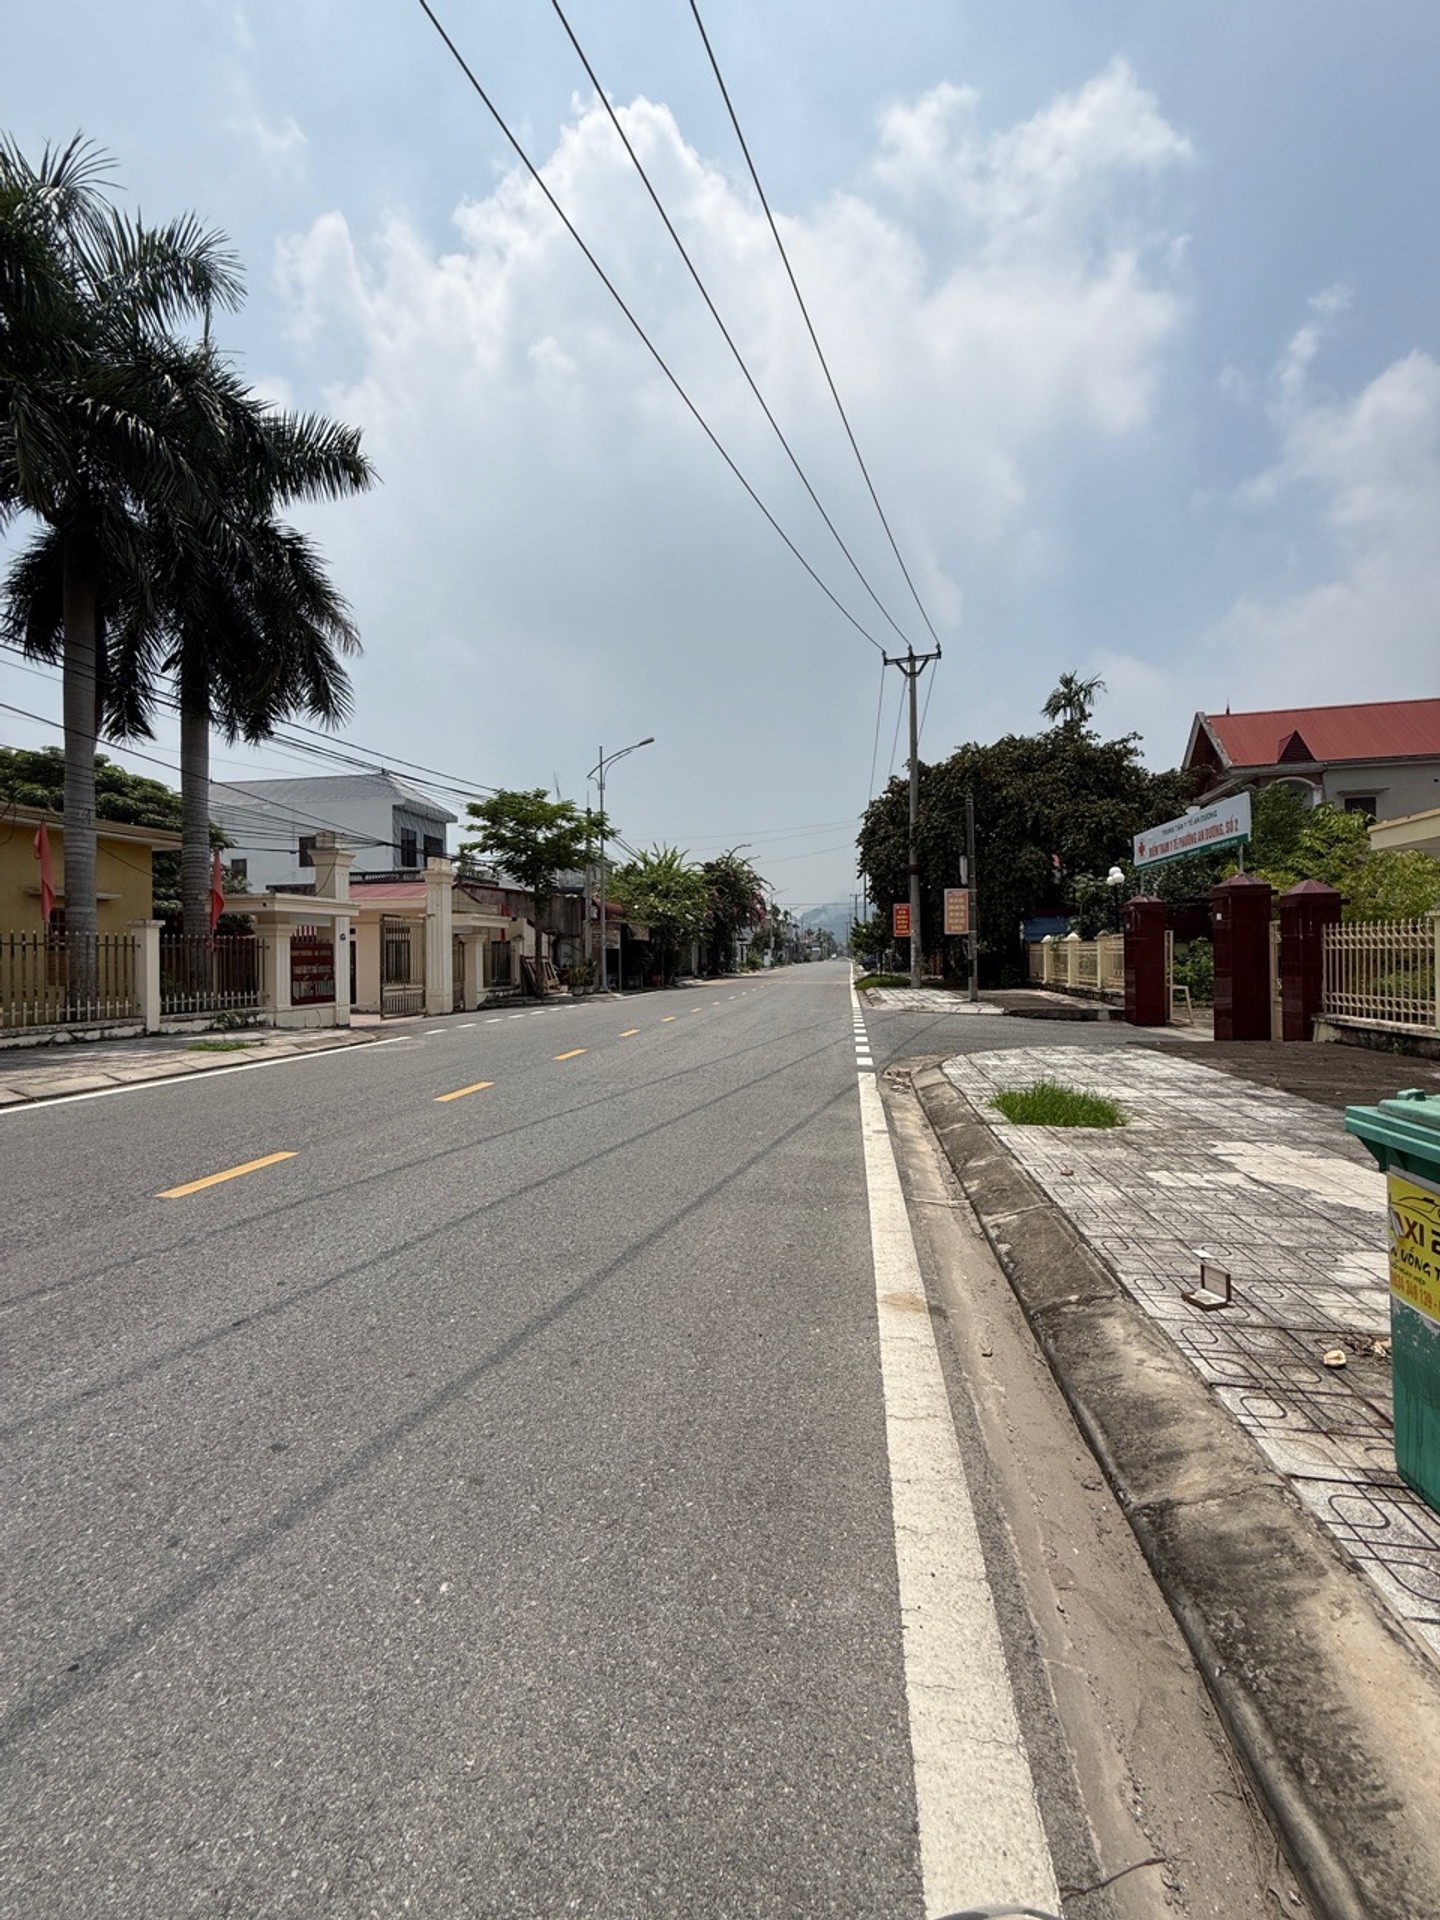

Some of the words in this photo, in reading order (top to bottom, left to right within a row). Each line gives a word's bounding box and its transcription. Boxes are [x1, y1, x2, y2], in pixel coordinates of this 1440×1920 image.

[1197, 829, 1204, 843] AN
[1225, 814, 1234, 834] SỐ
[1234, 818, 1239, 832] 2
[1401, 1246, 1431, 1278] UỐNG
